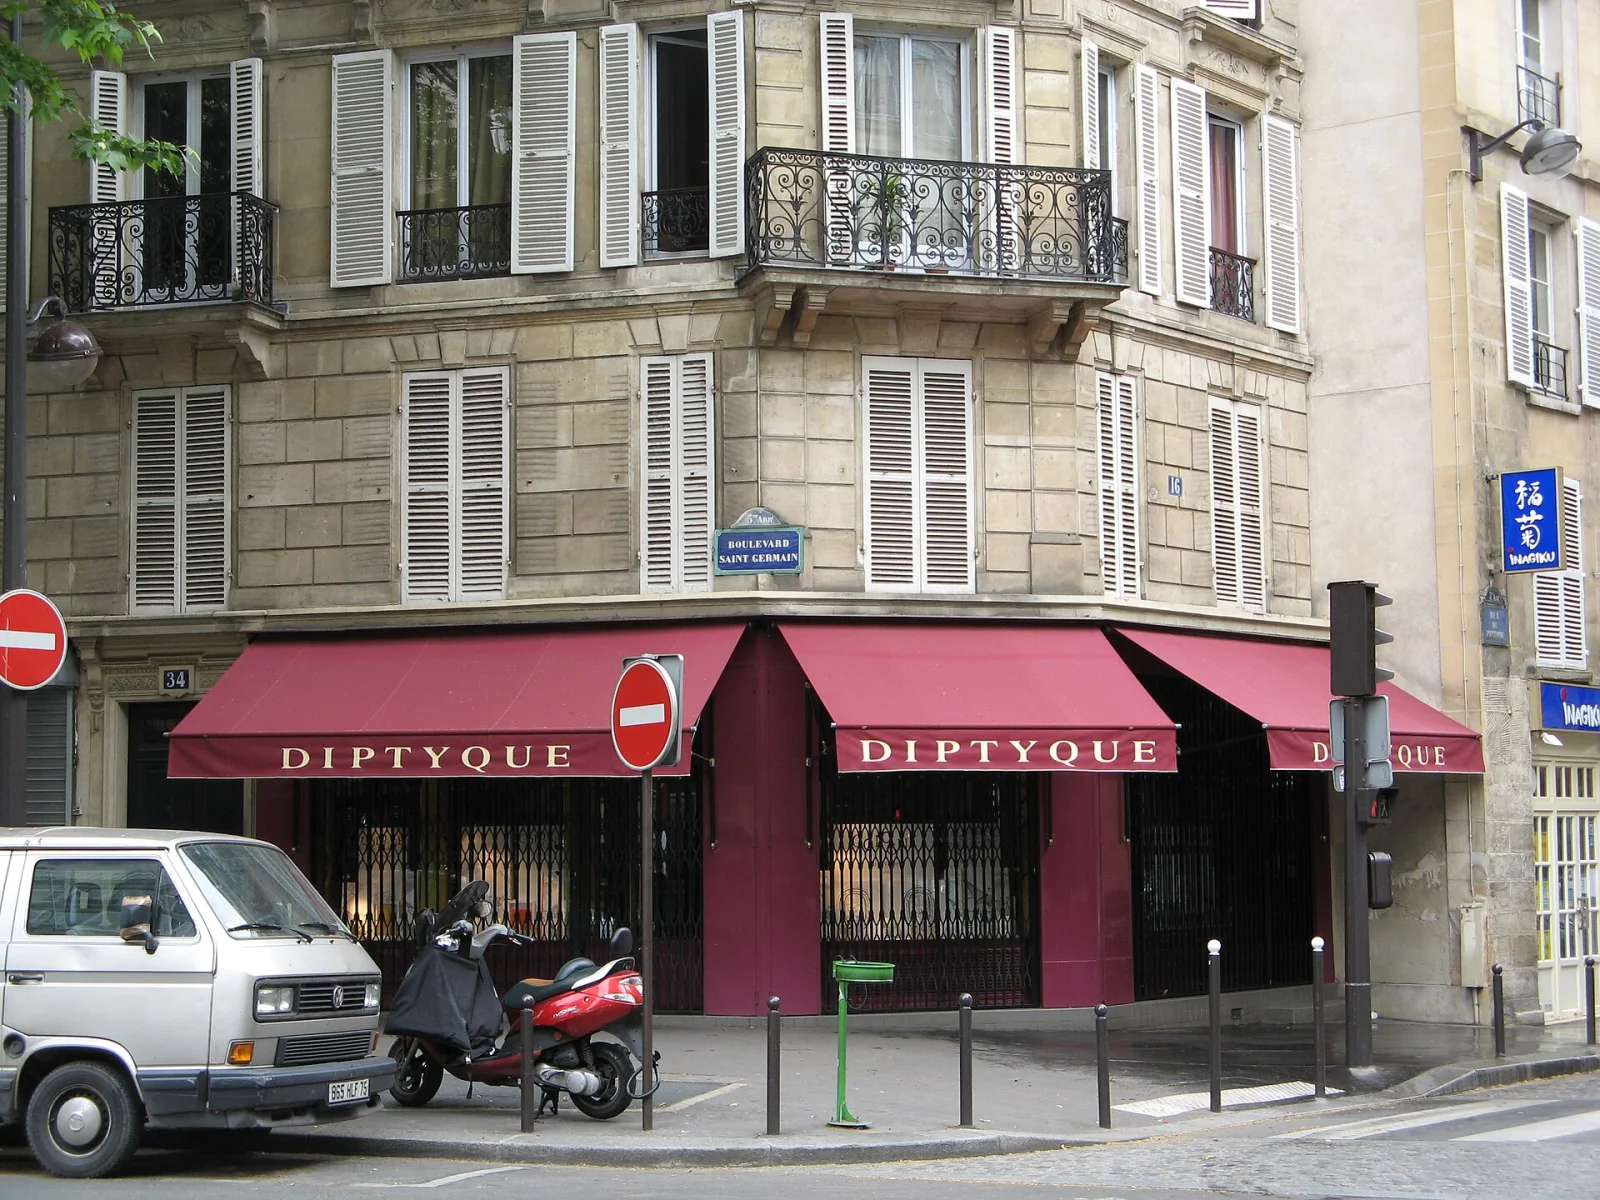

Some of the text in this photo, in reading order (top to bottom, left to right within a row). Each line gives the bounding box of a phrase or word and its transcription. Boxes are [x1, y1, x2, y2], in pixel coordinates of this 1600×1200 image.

[1171, 476, 1181, 495] 16
[728, 539, 790, 549] BOULEVARD
[719, 553, 798, 564] SAINT GERMAIN
[1508, 550, 1556, 566] INAGIKU
[166, 671, 186, 688] 34
[281, 744, 571, 774] DIPTYQUE
[859, 739, 1157, 767] DIPTYQUE
